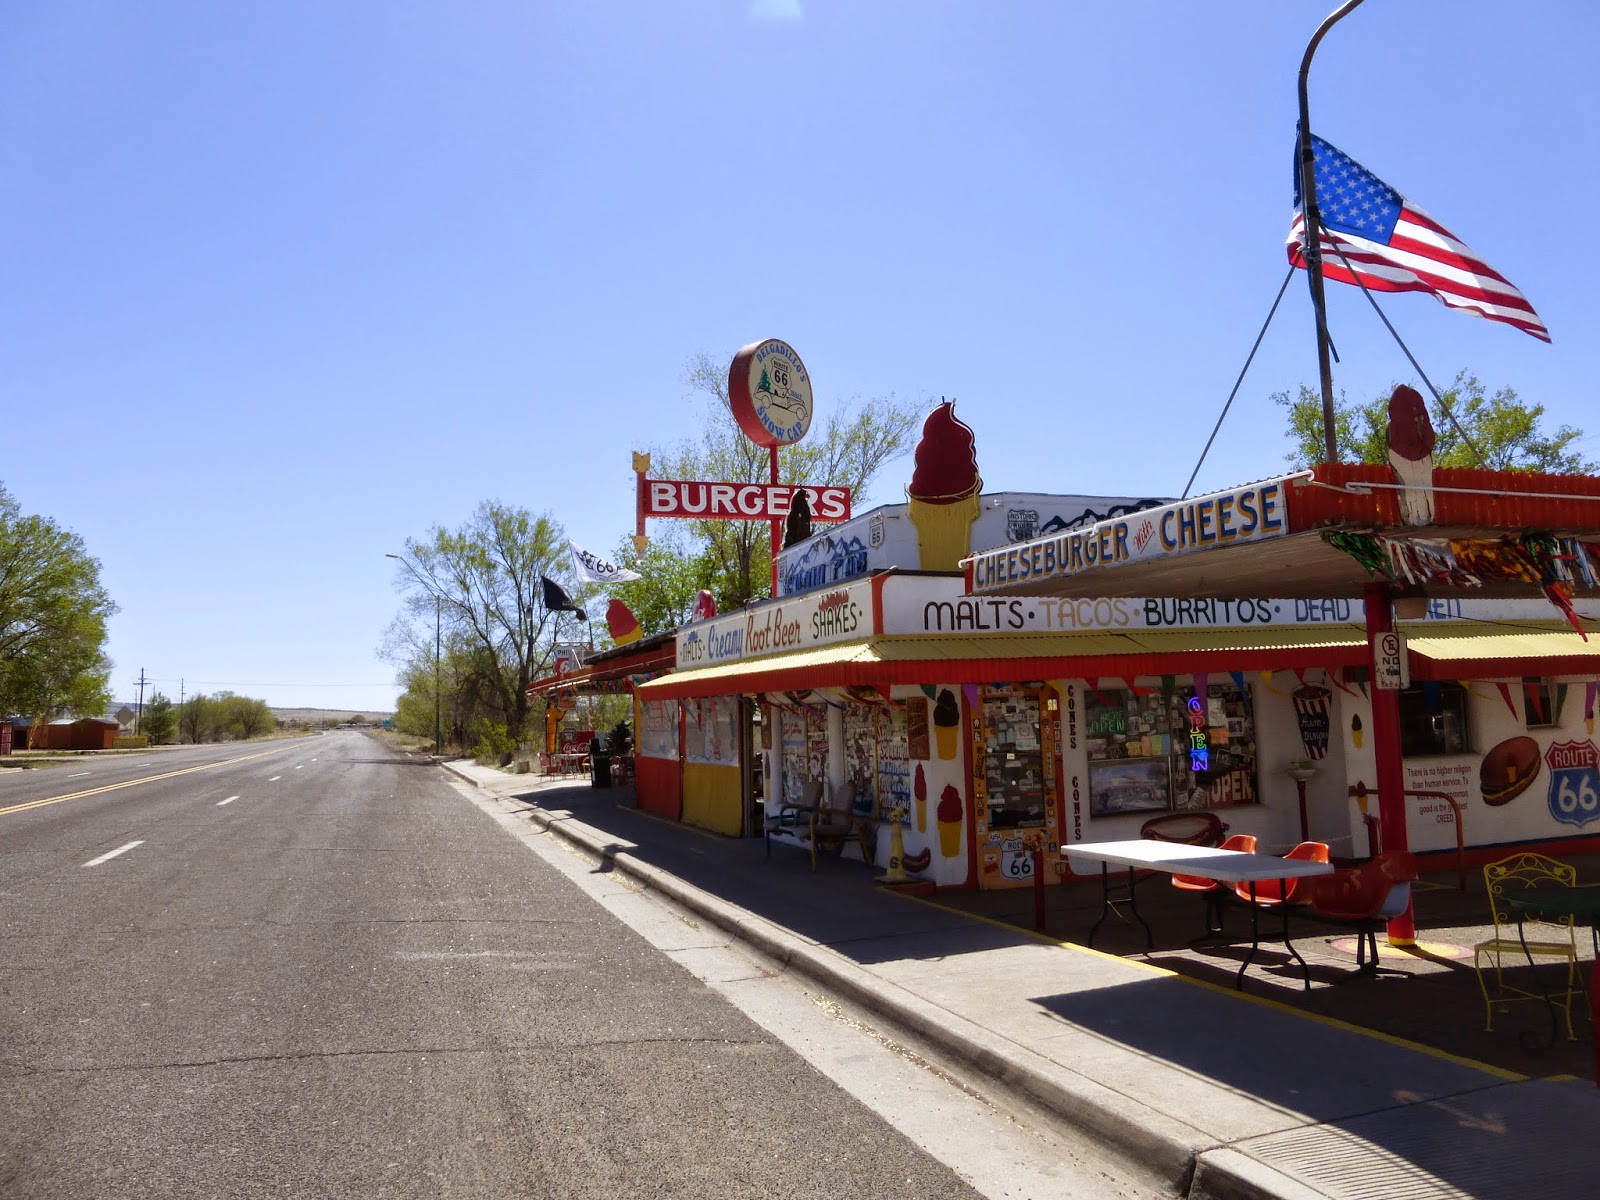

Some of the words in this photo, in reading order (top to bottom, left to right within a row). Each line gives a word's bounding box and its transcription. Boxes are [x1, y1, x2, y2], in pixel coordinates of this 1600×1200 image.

[756, 343, 806, 382] DELGADILLO'S
[773, 360, 789, 371] ROUTE
[774, 369, 788, 386] 66
[757, 406, 785, 440] SNOW
[787, 421, 803, 441] CAP
[651, 482, 845, 518] BURGERS
[1010, 512, 1036, 520] HISTORIC
[974, 521, 1130, 588] CHEESEBURGER
[1159, 485, 1282, 552] CHEESE
[596, 559, 614, 573] 66
[924, 600, 1025, 630] MALTS
[1038, 598, 1130, 628] TACOS
[1143, 598, 1273, 626] BURRITOS
[1295, 599, 1350, 621] DEAD
[683, 639, 702, 662] MALTS
[708, 625, 744, 660] Creamy
[745, 610, 771, 653] Root
[773, 608, 802, 648] Beer
[812, 602, 858, 640] SHAKES
[1067, 685, 1077, 749] CONES
[1091, 719, 1125, 733] OPEN
[1187, 696, 1209, 772] OPEN
[1554, 748, 1594, 767] ROUTE
[1407, 768, 1423, 777] There
[1424, 768, 1429, 776] is
[1436, 766, 1452, 777] higher
[1453, 765, 1472, 775] religion
[1211, 769, 1253, 803] OPEN
[1412, 780, 1424, 789] than
[1424, 780, 1442, 788] human
[1462, 776, 1469, 785] To
[1558, 774, 1598, 813] 66
[1072, 776, 1082, 841] CONES
[1419, 804, 1433, 815] good
[1439, 804, 1447, 812] the
[1436, 813, 1454, 824] CREED
[1008, 842, 1022, 850] ROU
[1010, 858, 1031, 875] 66
